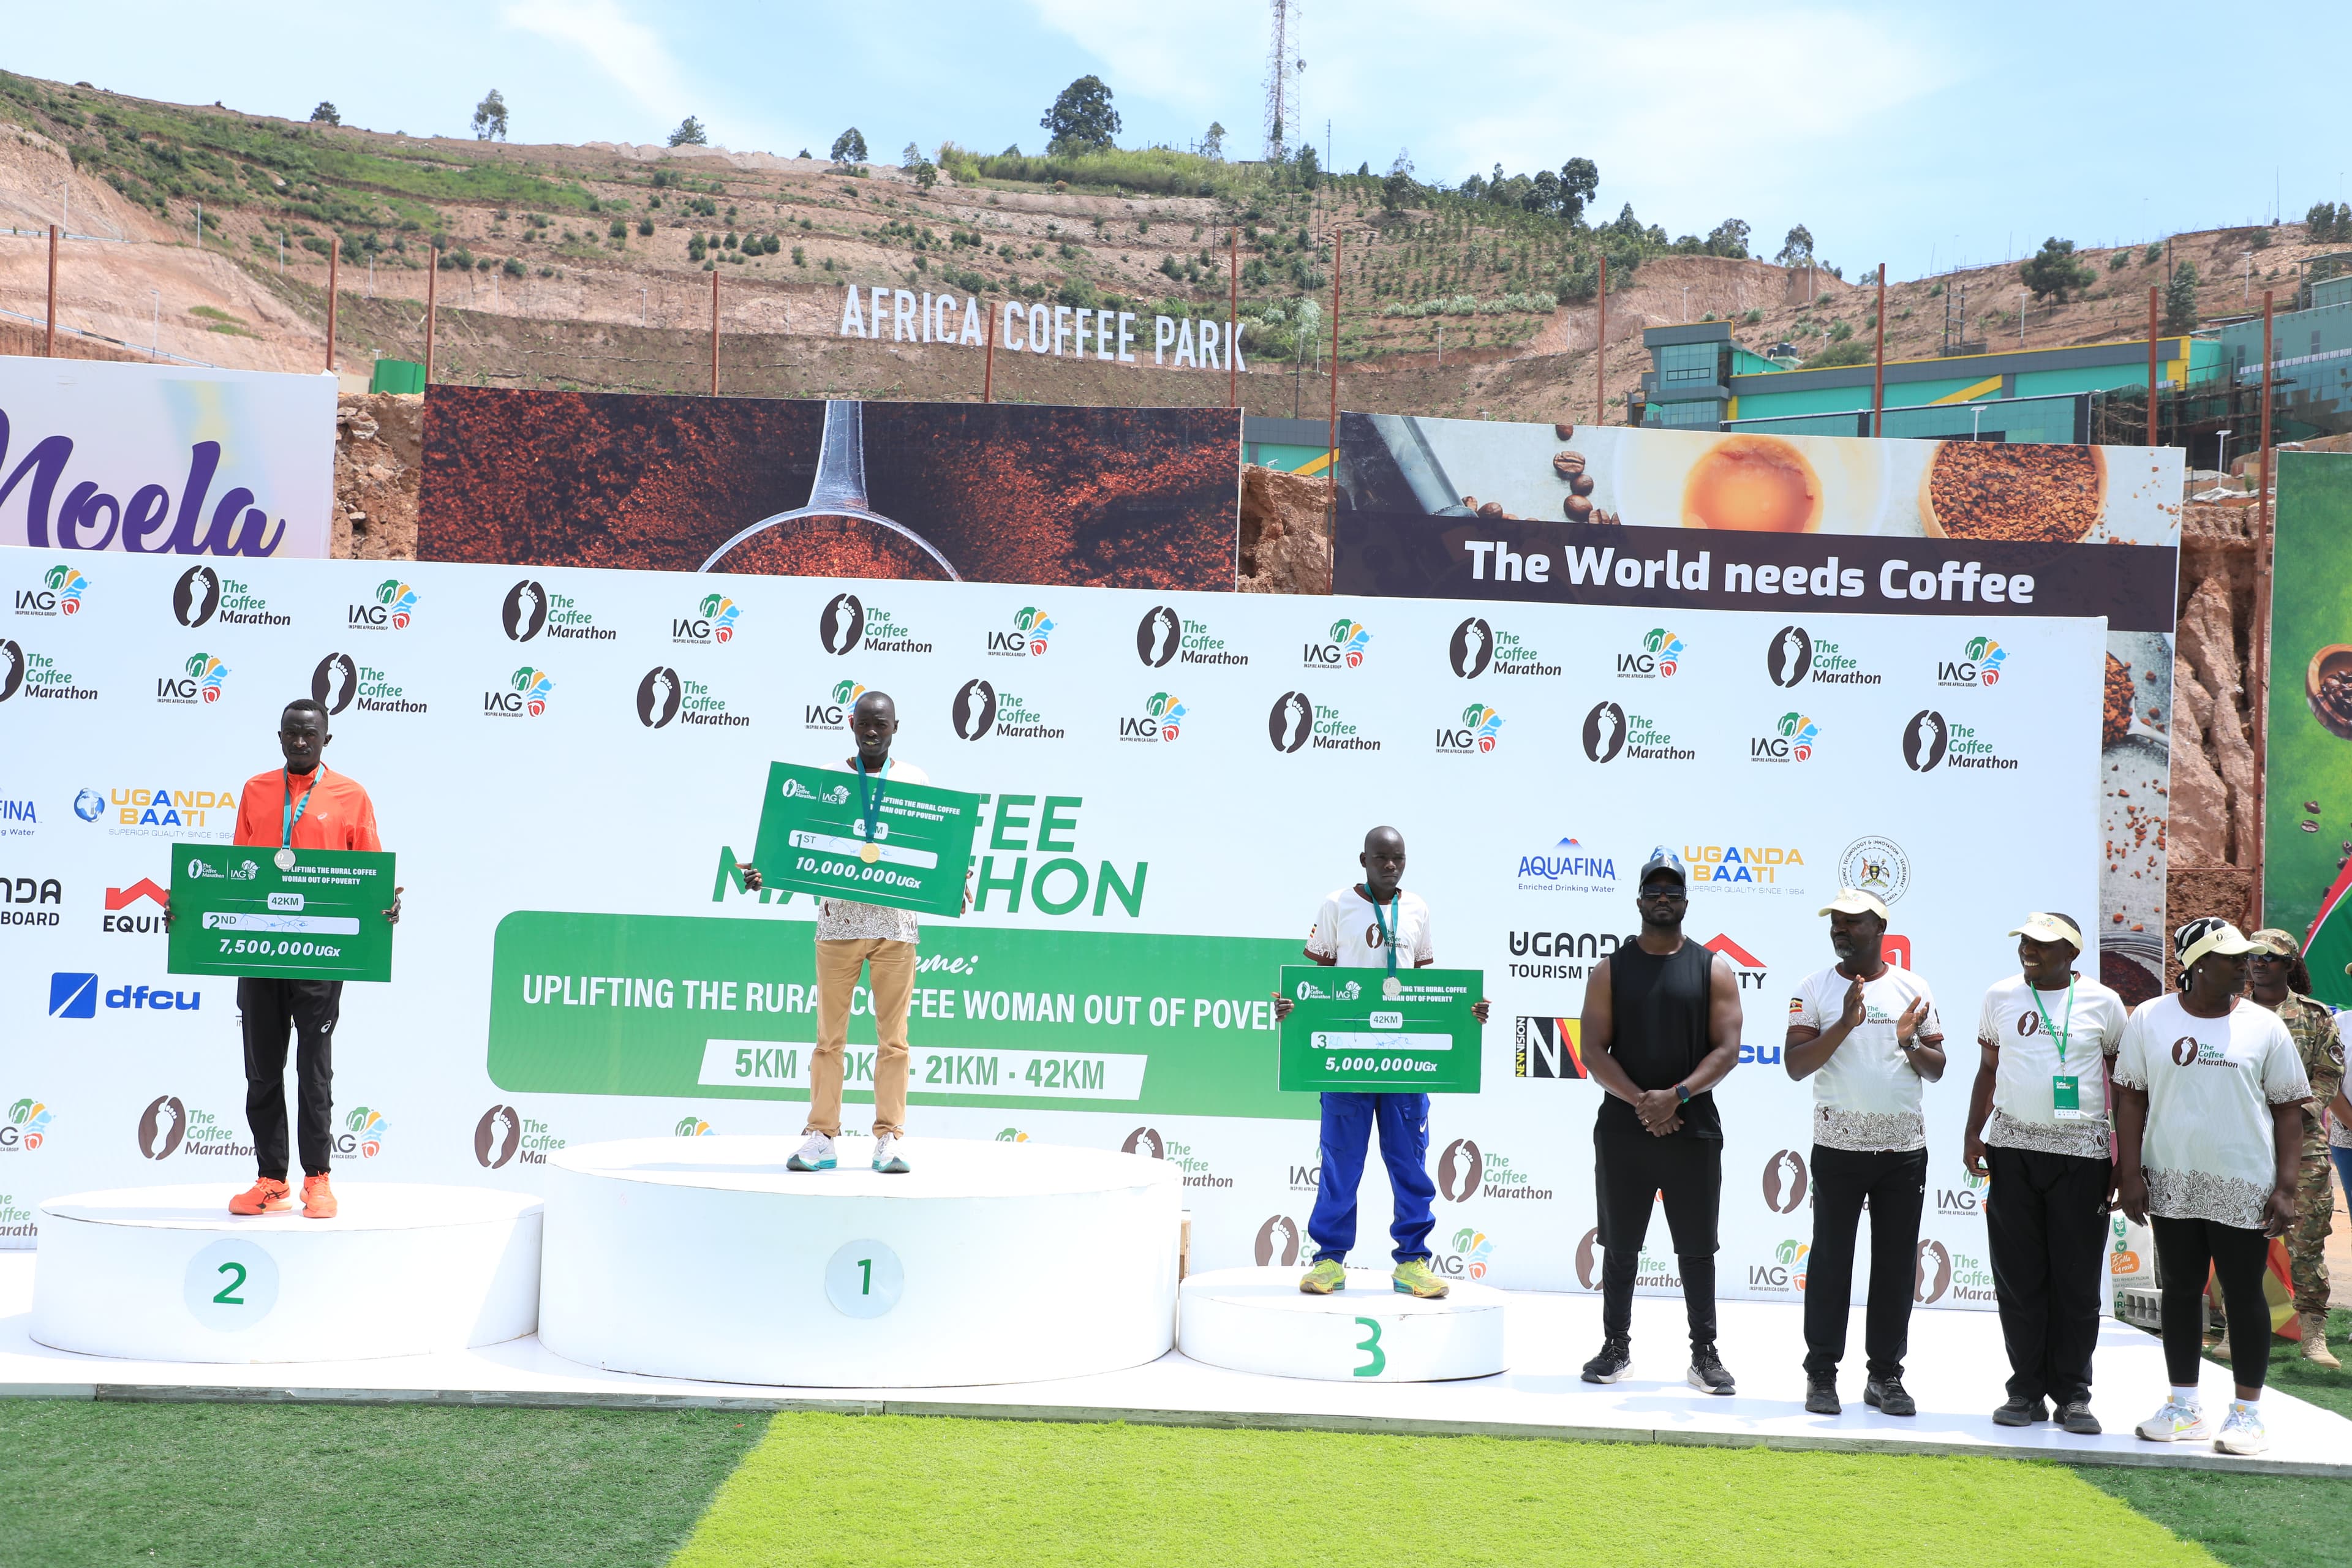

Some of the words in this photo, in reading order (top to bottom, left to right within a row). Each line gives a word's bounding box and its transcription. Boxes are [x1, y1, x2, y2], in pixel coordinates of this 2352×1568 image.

[840, 284, 982, 347] AFRICA
[1003, 301, 1136, 363] COFFEE
[1155, 316, 1246, 371] PARK
[1465, 541, 1550, 582] The
[1565, 546, 1710, 590] World
[1725, 557, 1864, 597] needs
[1880, 560, 2034, 603] Coffee
[222, 580, 247, 593] The
[16, 590, 56, 610] IAG
[221, 595, 265, 610] Coffee
[549, 595, 574, 608] The
[220, 610, 290, 625] Marathon
[349, 605, 387, 624] IAG
[548, 610, 592, 625] Coffee
[867, 608, 890, 621] The
[548, 625, 616, 639] Marathon
[673, 619, 710, 638] IAG
[865, 623, 908, 638] Coffee
[1183, 620, 1207, 633] The
[864, 638, 932, 652] Marathon
[989, 632, 1025, 650] IAG
[1182, 635, 1224, 650] Coffee
[1496, 631, 1519, 644] The
[1304, 644, 1340, 663] IAG
[1494, 647, 1537, 661] Coffee
[1814, 640, 1838, 653] The
[28, 654, 53, 667] The
[1181, 650, 1248, 665] Marathon
[1618, 654, 1654, 673] IAG
[1813, 655, 1856, 669] Coffee
[26, 669, 72, 684] Coffee
[360, 668, 384, 680] The
[1494, 662, 1561, 676] Marathon
[1939, 662, 1976, 681] IAG
[1812, 670, 1881, 684] Marathon
[25, 684, 97, 699] Marathon
[158, 679, 197, 698] IAG
[358, 682, 402, 698] Coffee
[684, 681, 707, 694] The
[358, 698, 427, 712] Marathon
[485, 692, 522, 711] IAG
[682, 696, 725, 711] Coffee
[999, 694, 1022, 706] The
[682, 711, 749, 726] Marathon
[806, 706, 843, 724] IAG
[998, 709, 1040, 723] Coffee
[1315, 706, 1338, 718] The
[1120, 718, 1157, 736] IAG
[1314, 721, 1356, 736] Coffee
[1629, 715, 1653, 728] The
[997, 723, 1064, 738] Marathon
[1628, 731, 1670, 745] Coffee
[1950, 725, 1974, 737] The
[1313, 736, 1380, 750] Marathon
[1437, 729, 1473, 748] IAG
[1627, 745, 1695, 760] Marathon
[1752, 738, 1789, 757] IAG
[1949, 739, 1992, 754] Coffee
[1948, 755, 2018, 769] Marathon
[111, 788, 236, 809] UGANDA
[822, 793, 837, 801] IAG
[916, 802, 937, 811] RURAL
[937, 805, 960, 815] COFFEE
[120, 809, 205, 827] BAATI
[916, 811, 944, 822] POVERTY
[1873, 840, 1899, 855] INNOVATION
[1684, 846, 1804, 865] UGANDA
[1518, 856, 1616, 880] AQUAFINA
[1694, 865, 1774, 883] BAATI
[271, 897, 299, 906] 42KM
[1, 911, 59, 925] BOARD
[1509, 964, 1582, 979] TOURISM
[106, 986, 200, 1010] dfcu
[524, 975, 673, 1008] UPLIFTING
[682, 980, 737, 1010] THE
[963, 990, 1074, 1022] WOMAN
[1085, 995, 1141, 1025] OUT
[1150, 997, 1185, 1026] OF
[736, 1049, 796, 1078] 5KM
[926, 1055, 998, 1085] 21KM
[1025, 1059, 1104, 1089] 42KM
[2198, 1058, 2238, 1068] Marathon
[189, 1110, 214, 1123] The
[187, 1126, 232, 1141] Coffee
[523, 1120, 548, 1133] The
[521, 1135, 565, 1150] Coffee
[1166, 1142, 1191, 1155] The
[1485, 1153, 1509, 1167] The
[1483, 1169, 1527, 1185] Coffee
[1483, 1185, 1552, 1199] Marathon
[1937, 1189, 1976, 1209] IAG
[1953, 1254, 1978, 1268] The
[213, 1262, 246, 1305] 2
[858, 1259, 872, 1295] 1
[1749, 1266, 1787, 1286] IAG
[1354, 1317, 1385, 1377] 3
